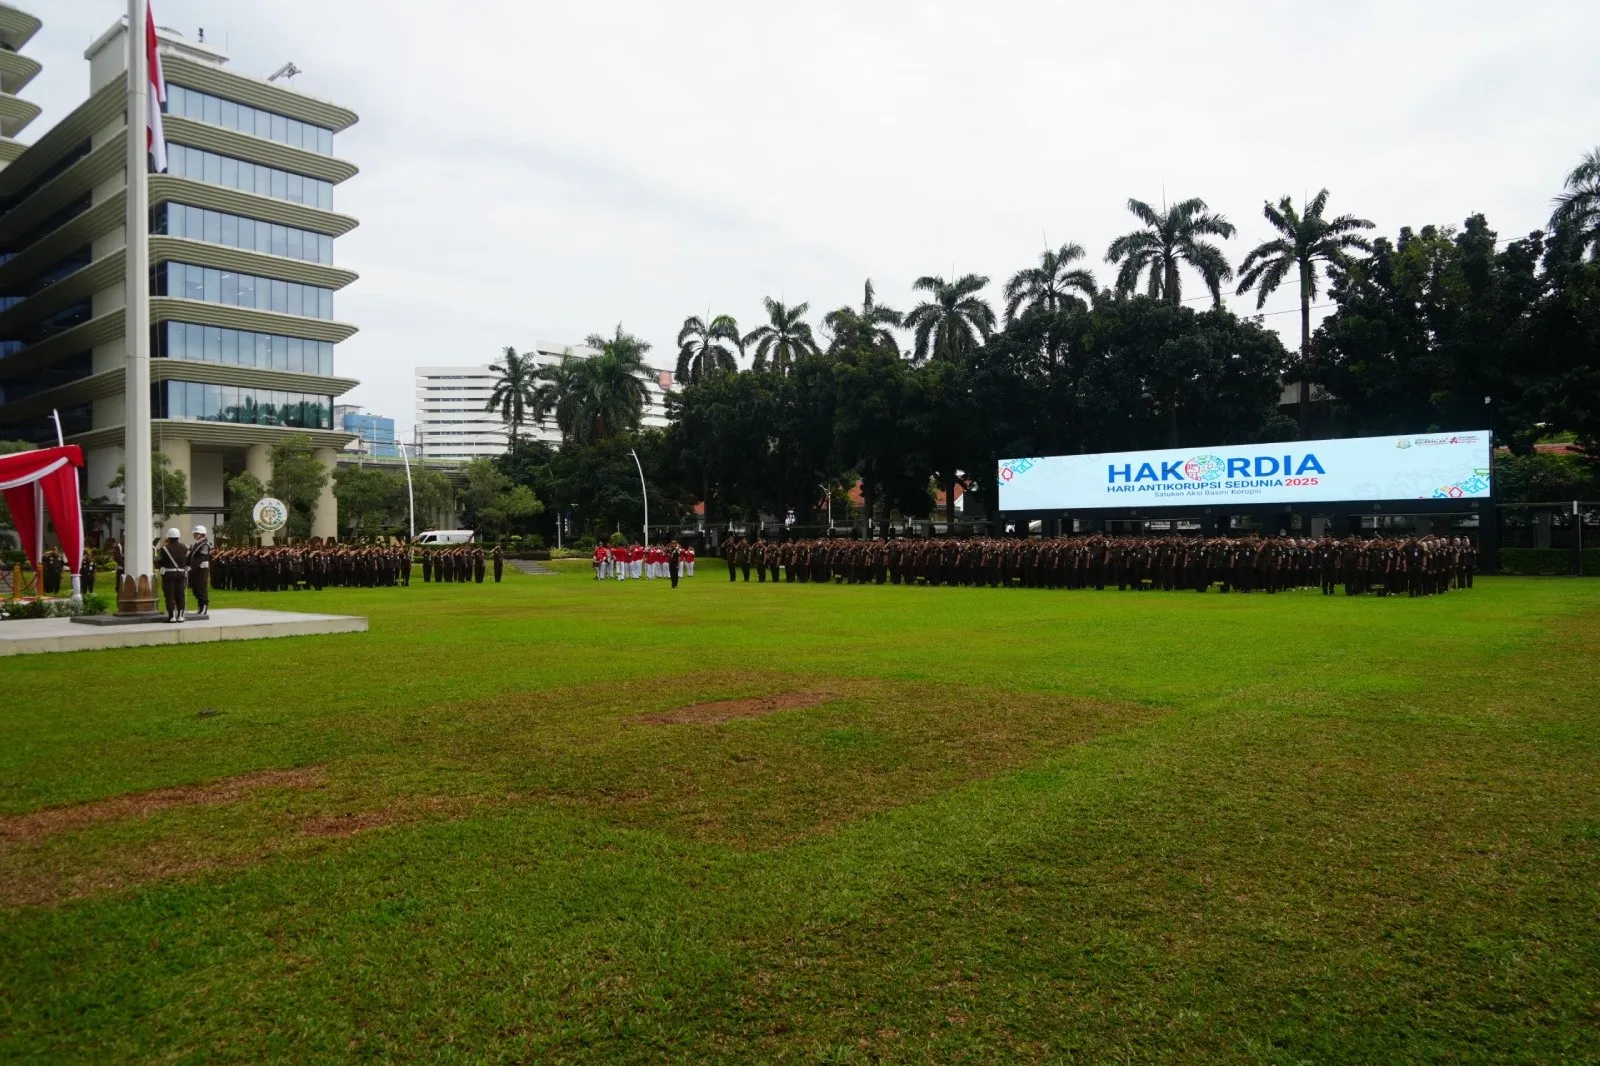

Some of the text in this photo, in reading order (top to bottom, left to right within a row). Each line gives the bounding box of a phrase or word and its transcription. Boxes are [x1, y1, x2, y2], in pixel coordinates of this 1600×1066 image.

[1107, 477, 1319, 493] HARI ANTIKORUPSI SEDUNIA 2025
[1204, 488, 1229, 496] Basmi
[1231, 488, 1262, 496] Korupsi
